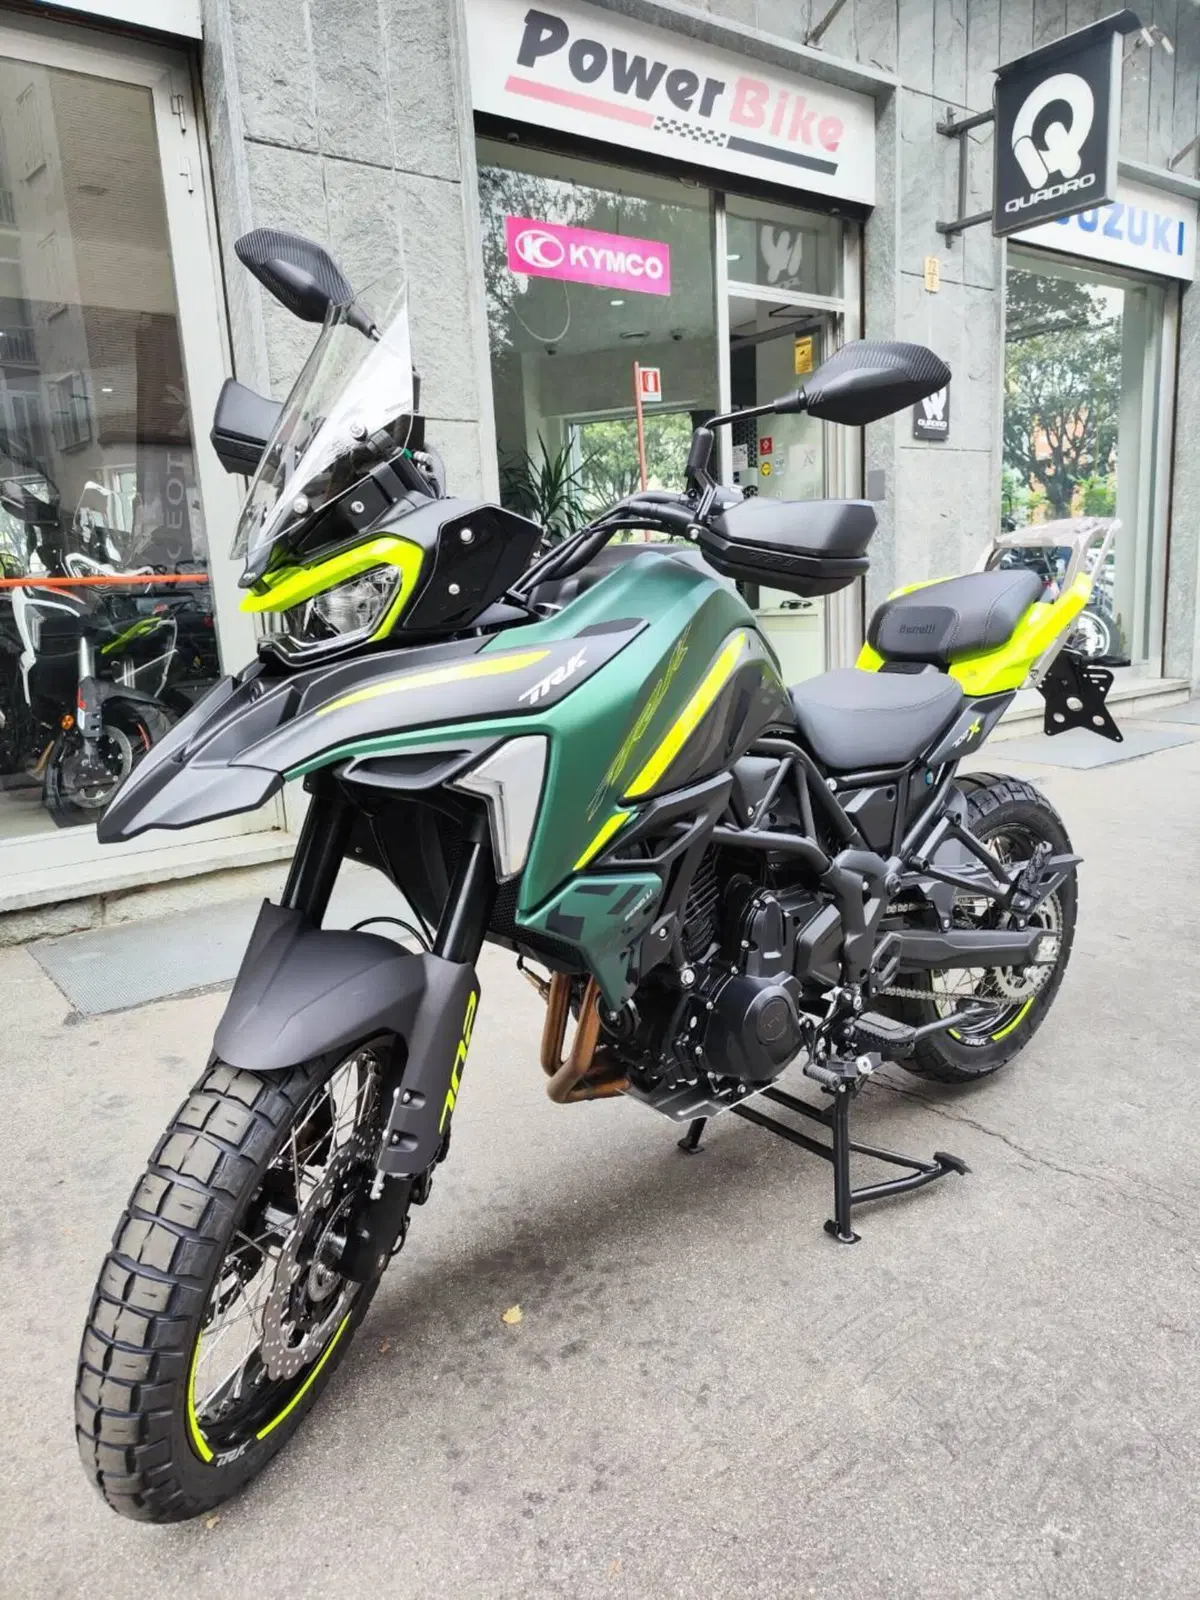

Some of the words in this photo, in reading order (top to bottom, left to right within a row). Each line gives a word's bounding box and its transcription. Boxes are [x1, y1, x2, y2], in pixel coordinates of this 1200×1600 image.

[1004, 172, 1097, 214] QUADRO
[1055, 202, 1185, 256] UZUKI
[569, 243, 664, 280] KYMCO
[518, 646, 588, 705] TRK
